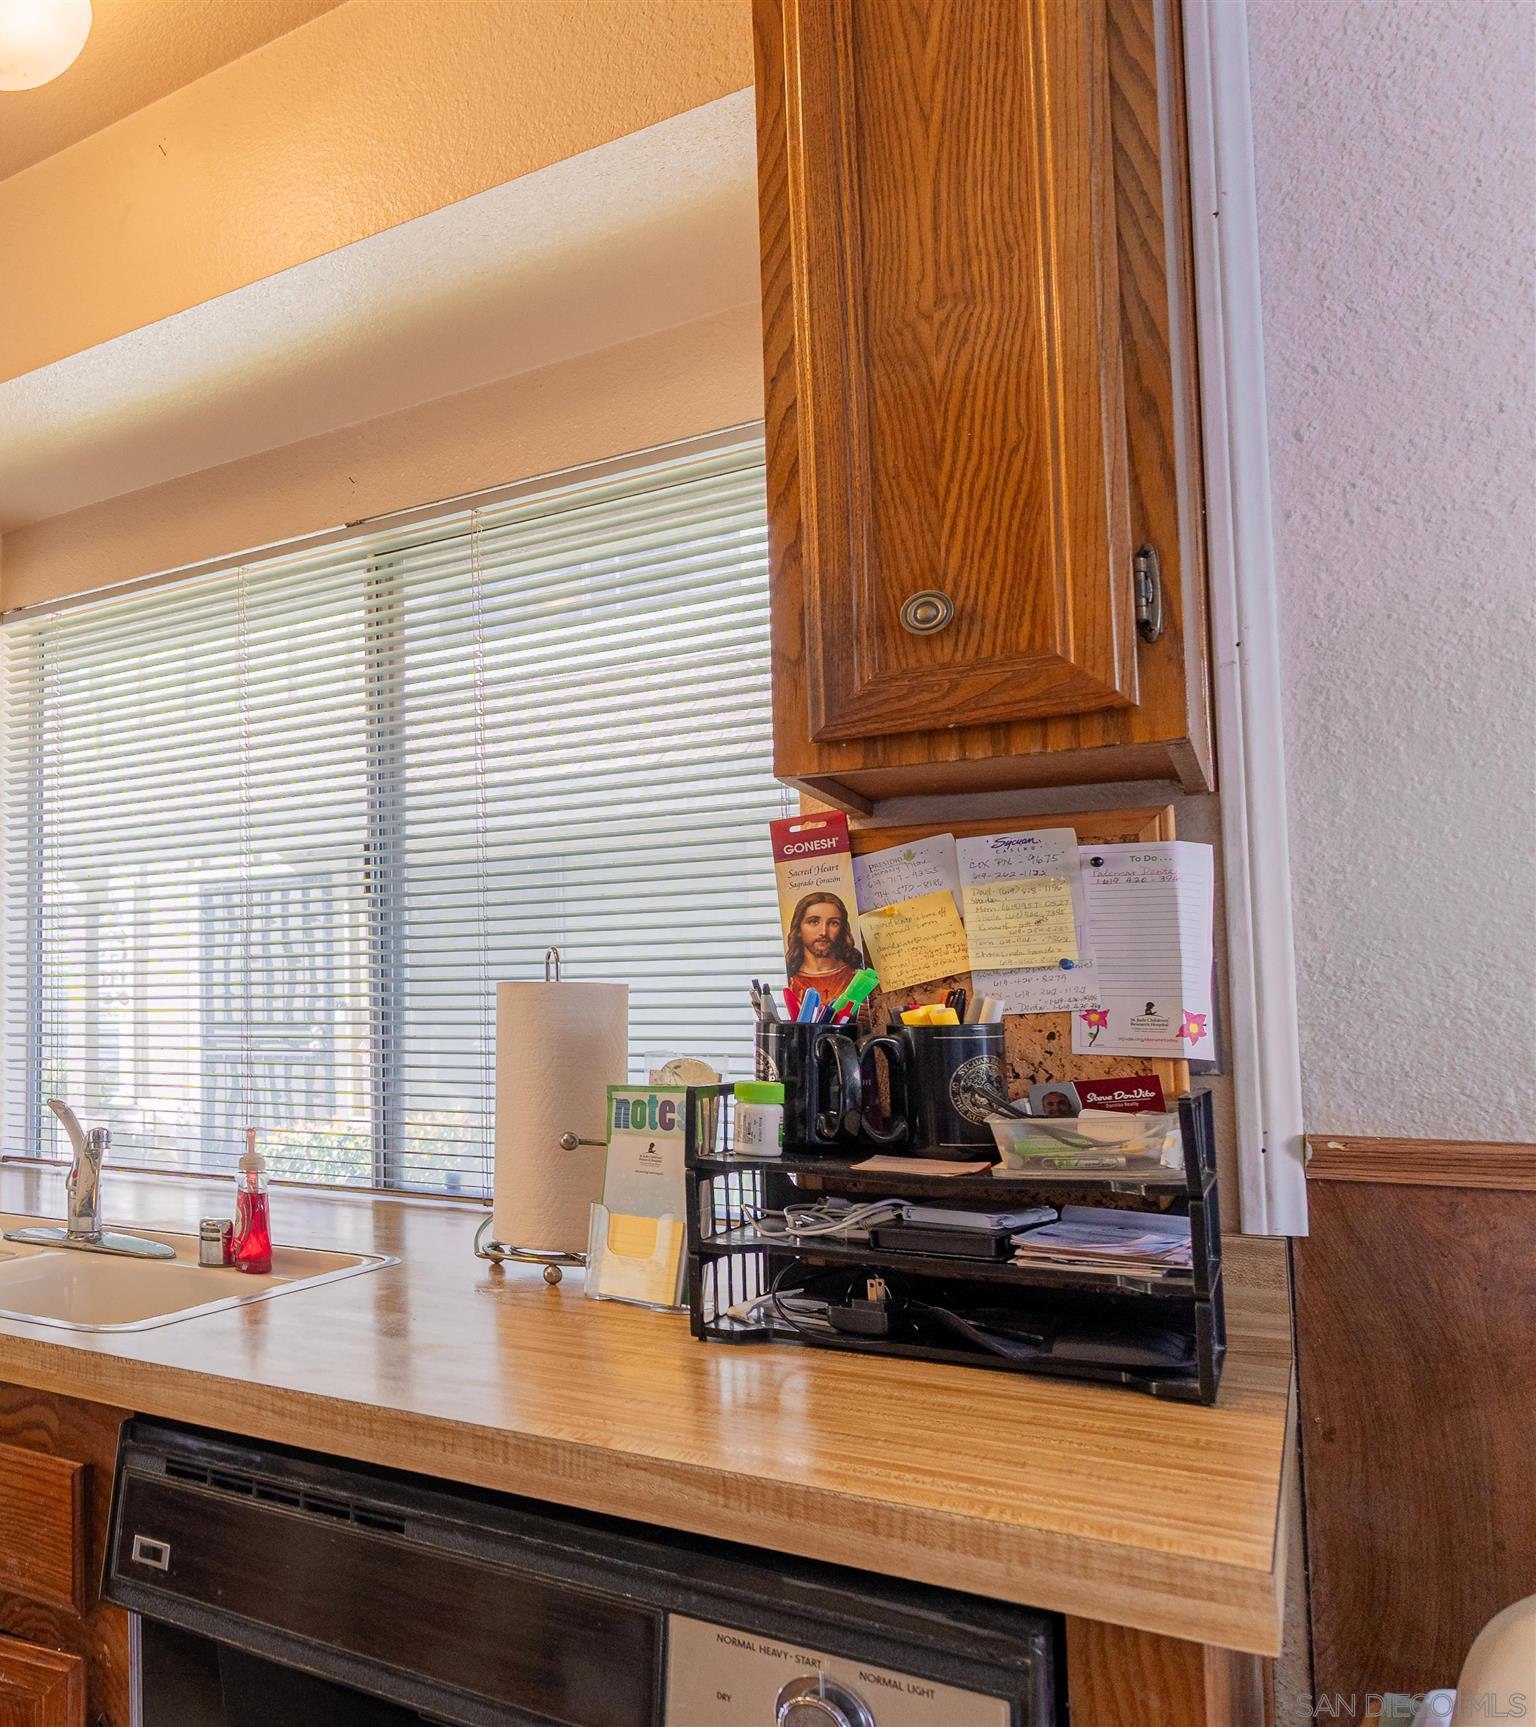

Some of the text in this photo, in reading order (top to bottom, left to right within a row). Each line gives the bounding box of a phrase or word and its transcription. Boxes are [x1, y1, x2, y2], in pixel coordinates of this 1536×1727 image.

[783, 837, 837, 855] GONESH
[990, 836, 1038, 849] Sycuan
[995, 846, 1035, 854] CASINO
[868, 856, 903, 873] PRESIDIO
[1129, 855, 1141, 863] To
[787, 862, 839, 879] Sacred Heart
[788, 876, 841, 890] Sagrado Corazón
[957, 1056, 990, 1077] SYCUAN
[1086, 1092, 1113, 1103] Steve
[614, 1094, 687, 1131] notes
[716, 1633, 756, 1652] NORMAL
[859, 1671, 935, 1700] NORMAL LIGHT
[716, 1691, 731, 1702] DRY
